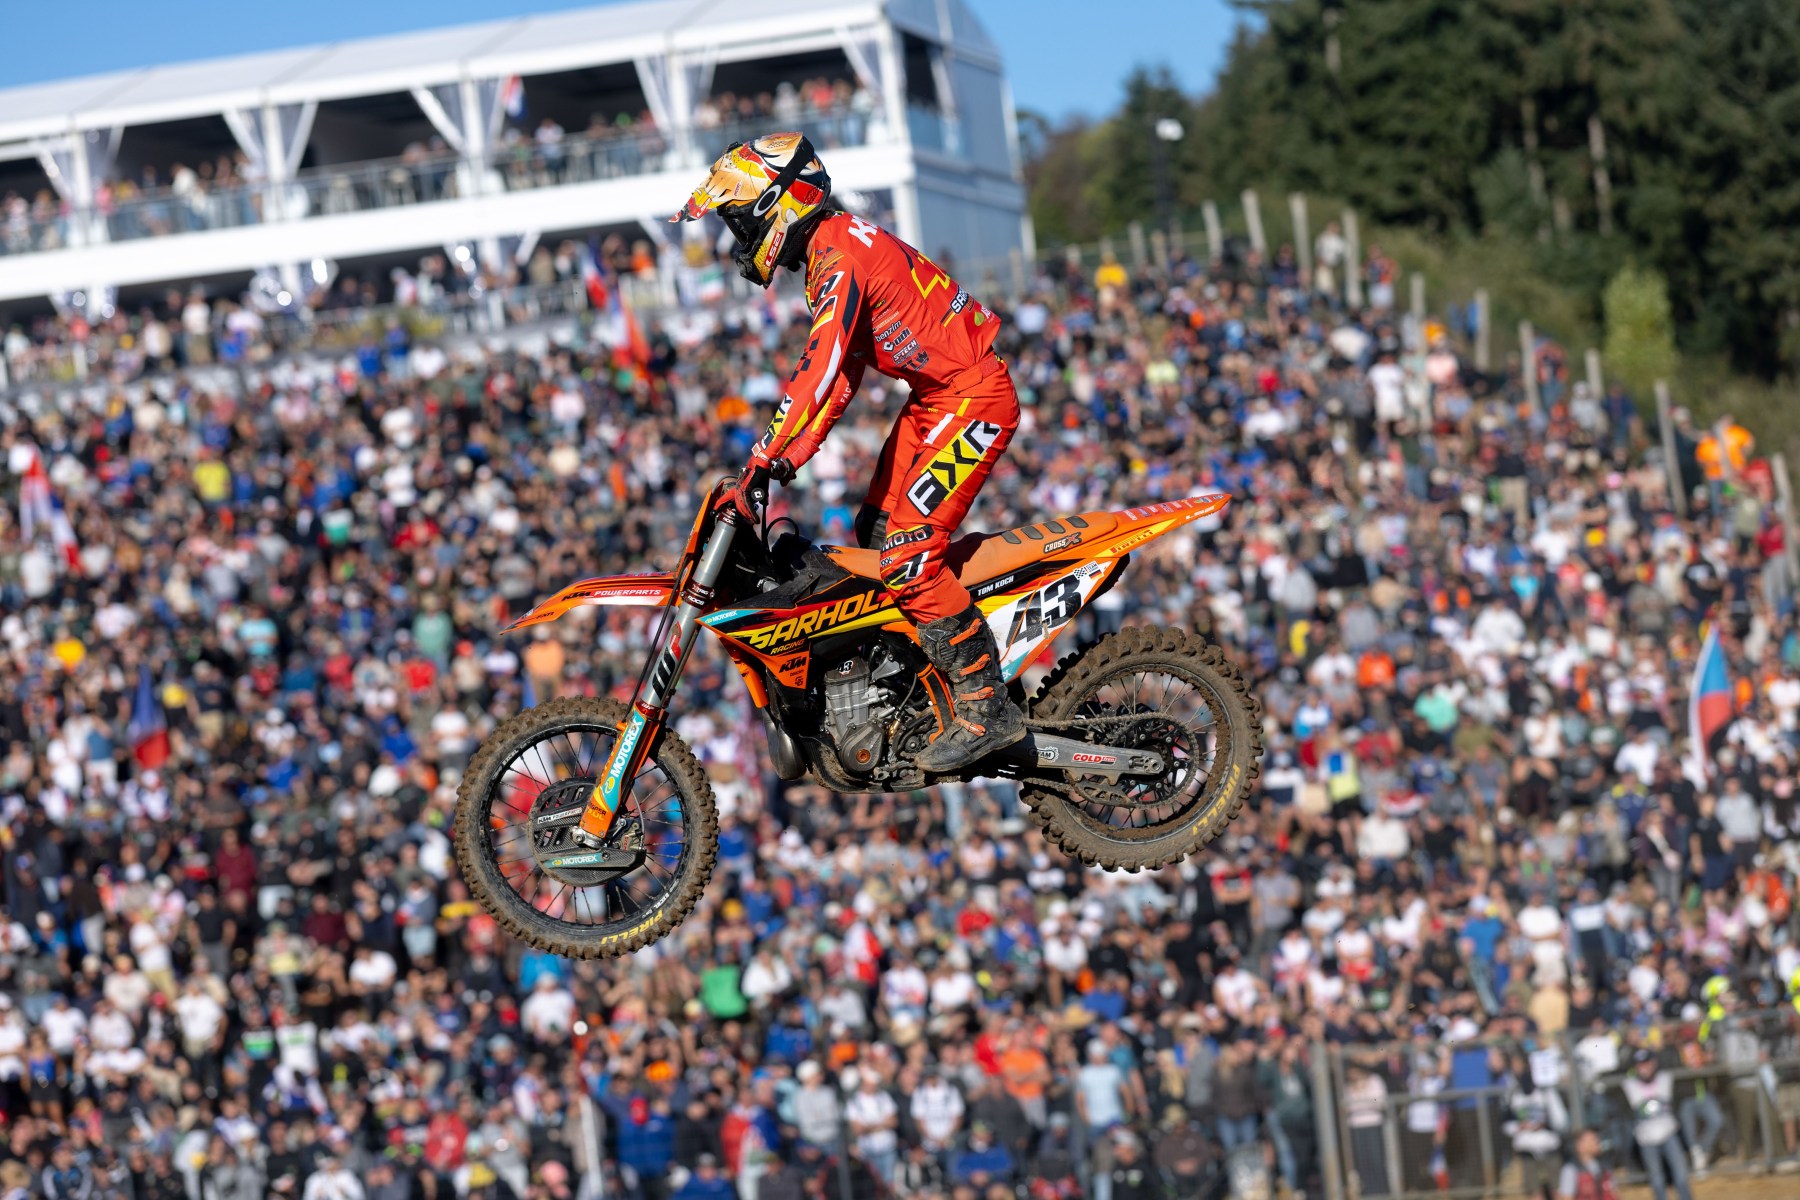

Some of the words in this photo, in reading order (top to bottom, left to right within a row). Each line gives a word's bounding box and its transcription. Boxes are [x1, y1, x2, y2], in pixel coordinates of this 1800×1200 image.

[906, 419, 1001, 518] FXR
[882, 528, 927, 552] MOTO
[594, 589, 661, 597] POWERPARTS
[978, 584, 993, 596] TOM
[995, 575, 1014, 589] KOCH
[712, 609, 738, 622] MOTOREX
[1006, 574, 1081, 648] 43
[770, 638, 806, 655] RACING
[779, 657, 808, 673] KTM
[611, 716, 643, 778] MOTOREX
[1073, 753, 1102, 763] GOLD
[1192, 763, 1241, 836] PIRELLI
[562, 855, 598, 865] MOTOREX
[601, 910, 663, 945] PIRELLI
